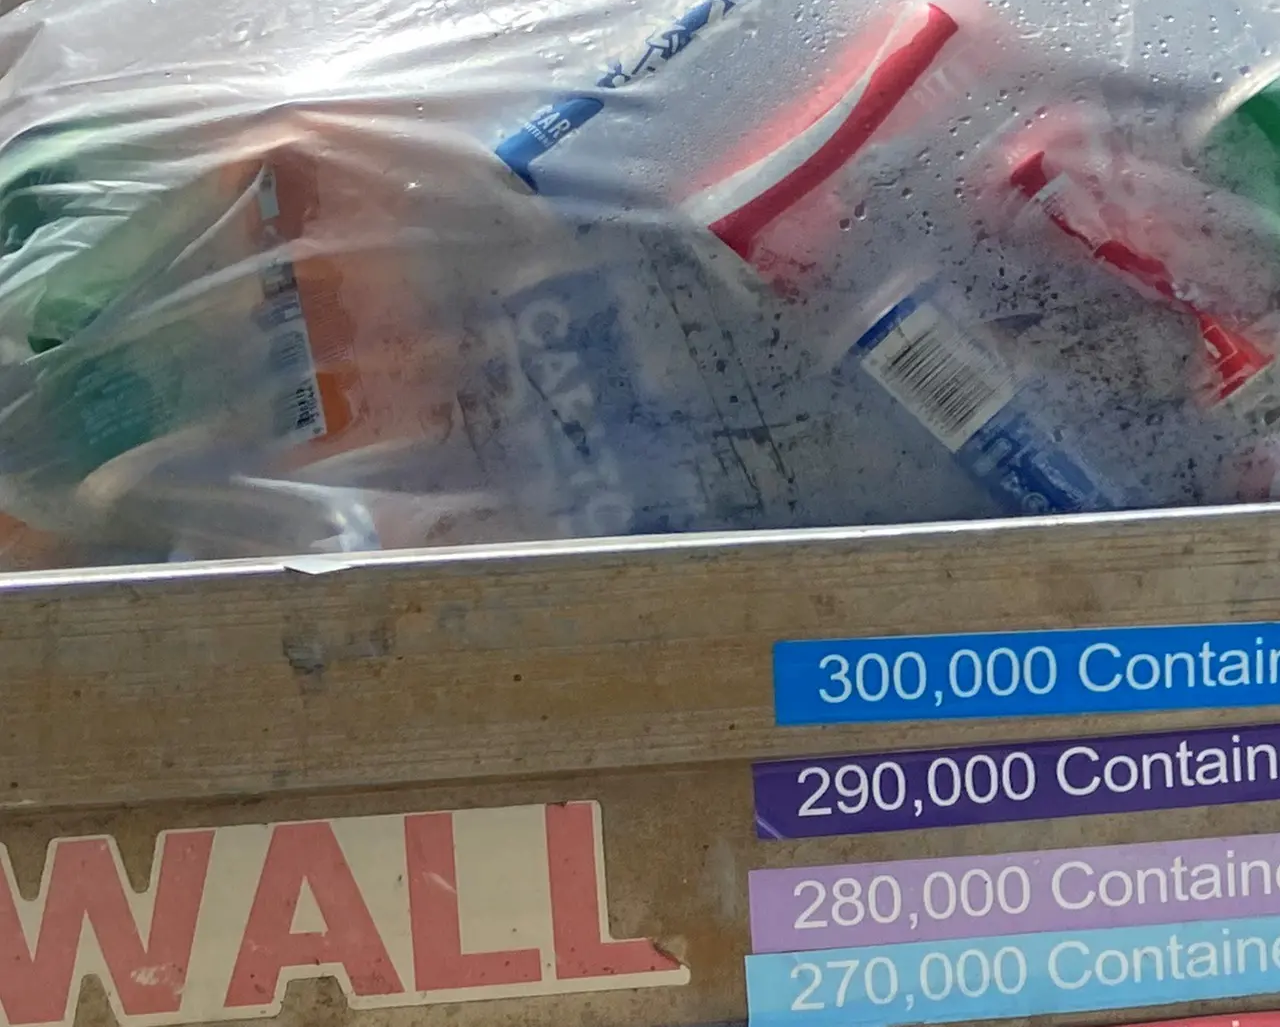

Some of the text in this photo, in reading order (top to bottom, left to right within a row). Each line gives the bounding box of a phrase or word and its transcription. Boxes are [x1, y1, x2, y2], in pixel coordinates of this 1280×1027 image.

[818, 645, 1057, 707] 300,000
[797, 751, 1036, 818] 290,000
[793, 865, 1031, 930] 280,000
[790, 946, 1027, 1012] 270,000
